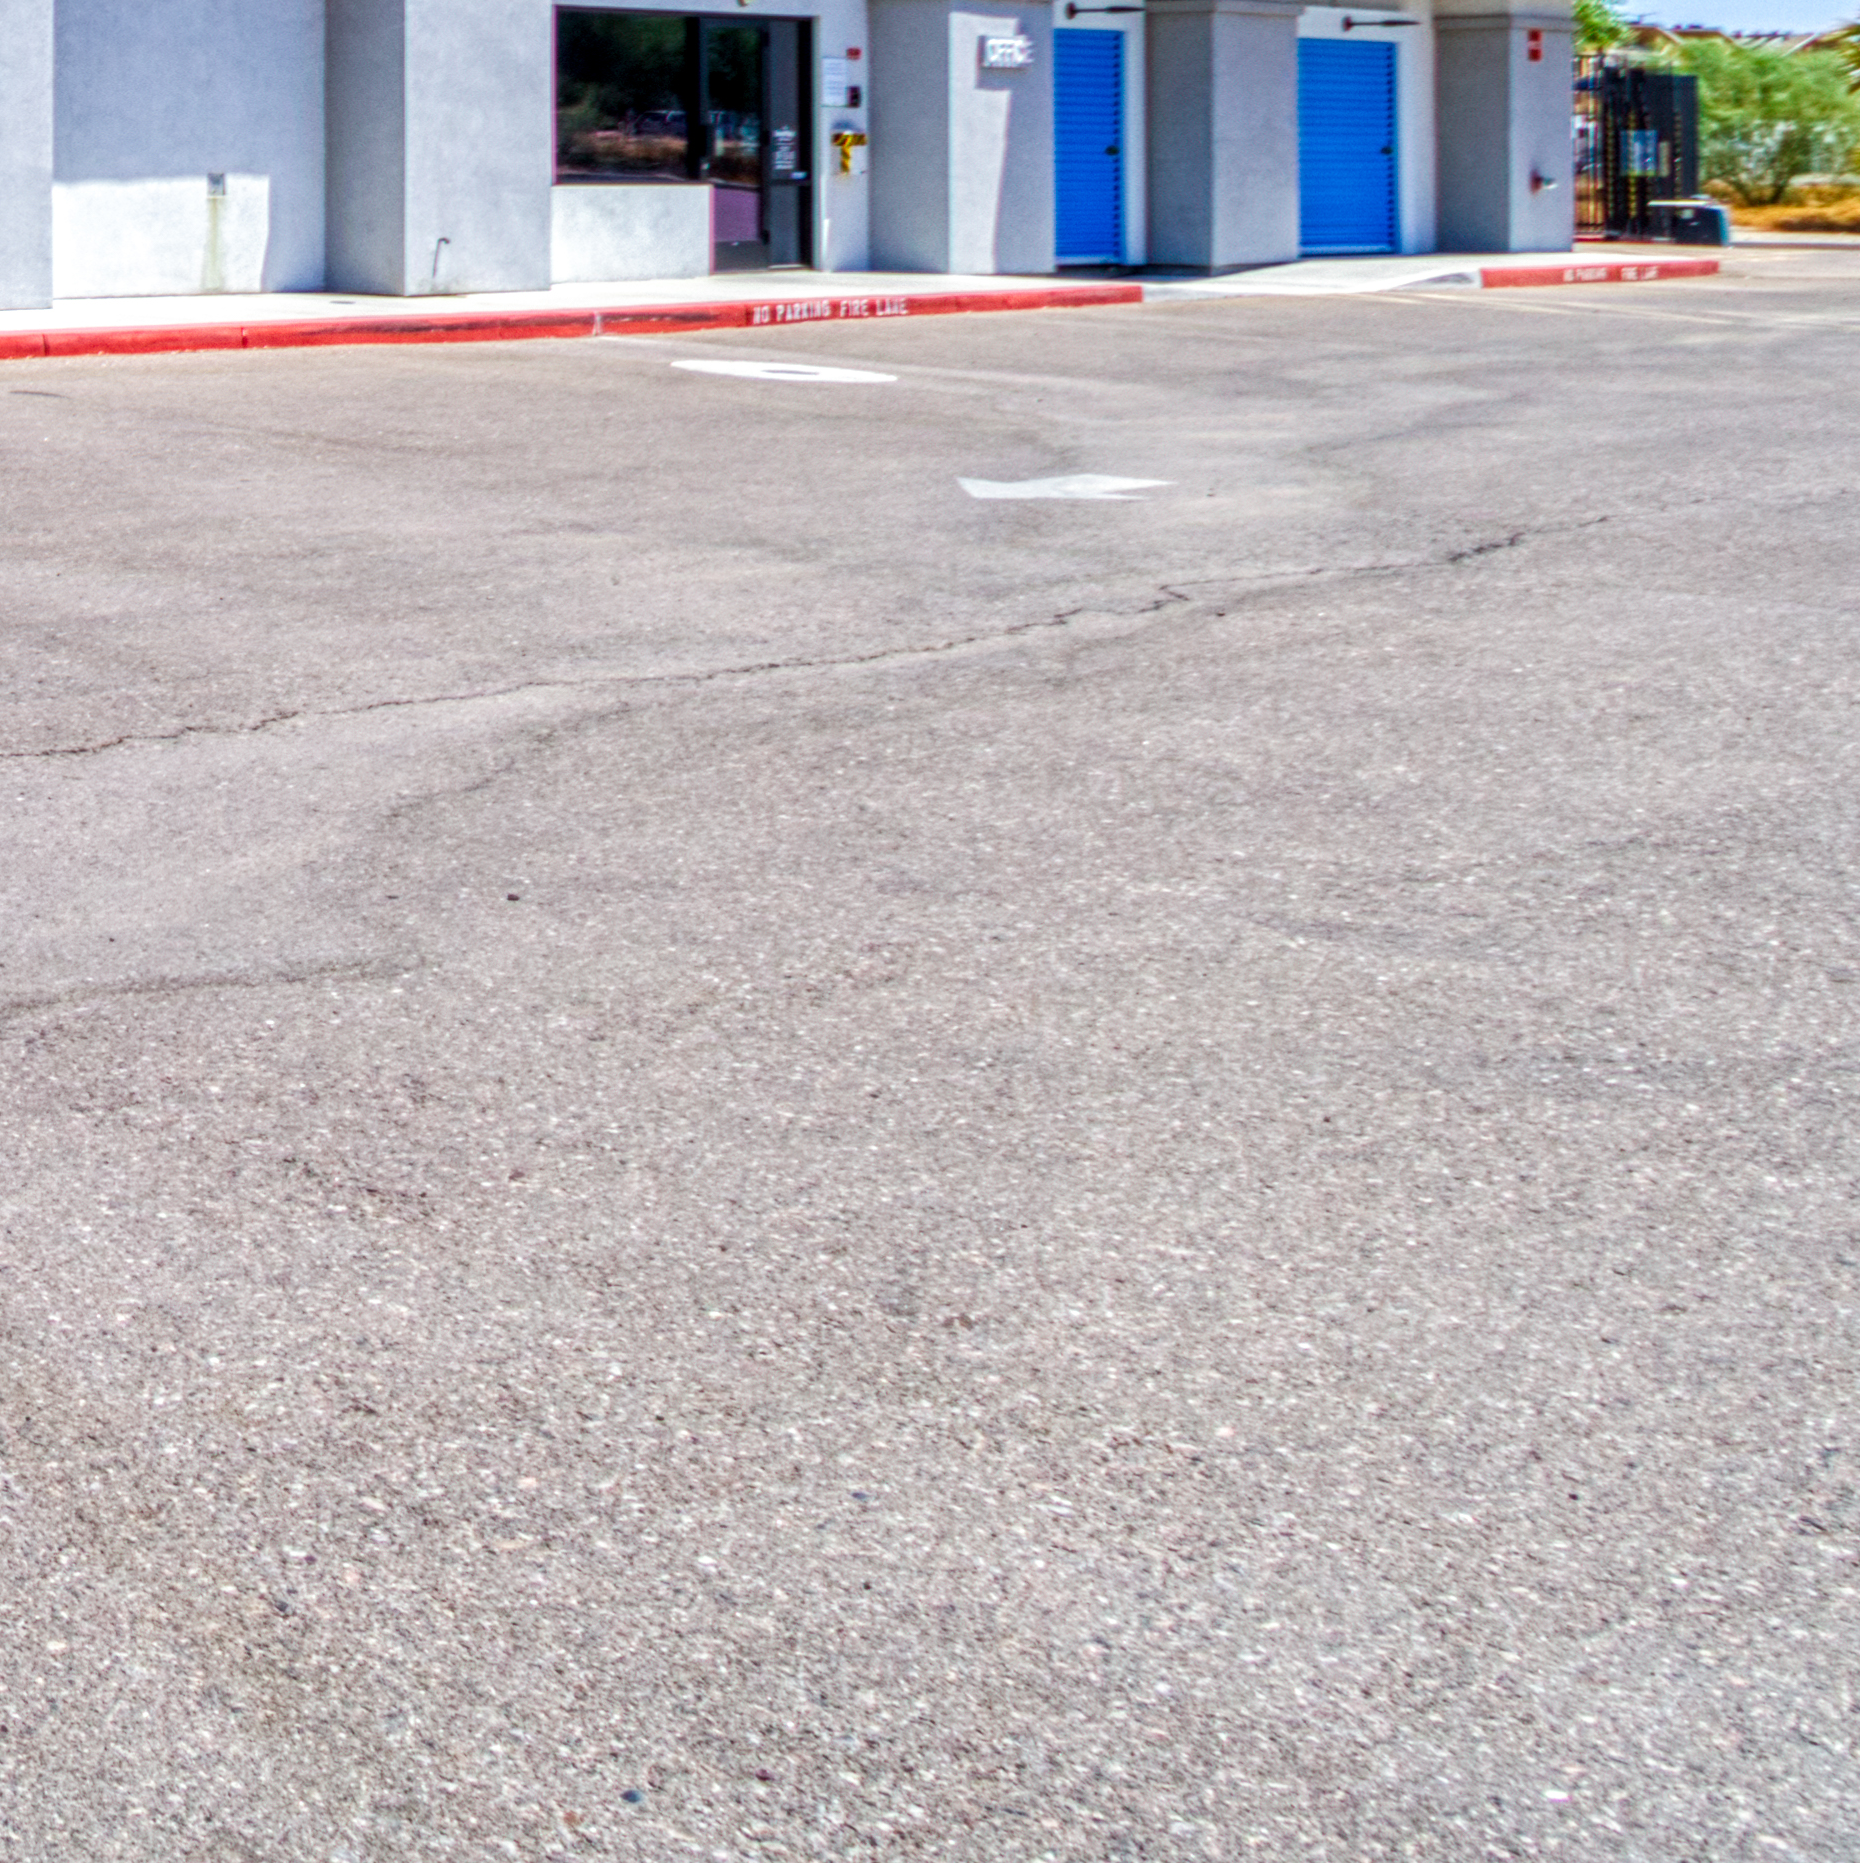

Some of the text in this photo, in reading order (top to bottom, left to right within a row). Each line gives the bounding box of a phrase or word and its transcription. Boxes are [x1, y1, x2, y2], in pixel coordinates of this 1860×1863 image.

[986, 37, 1034, 64] OFFICE
[753, 297, 908, 325] NO PARKING FIRE LANE
